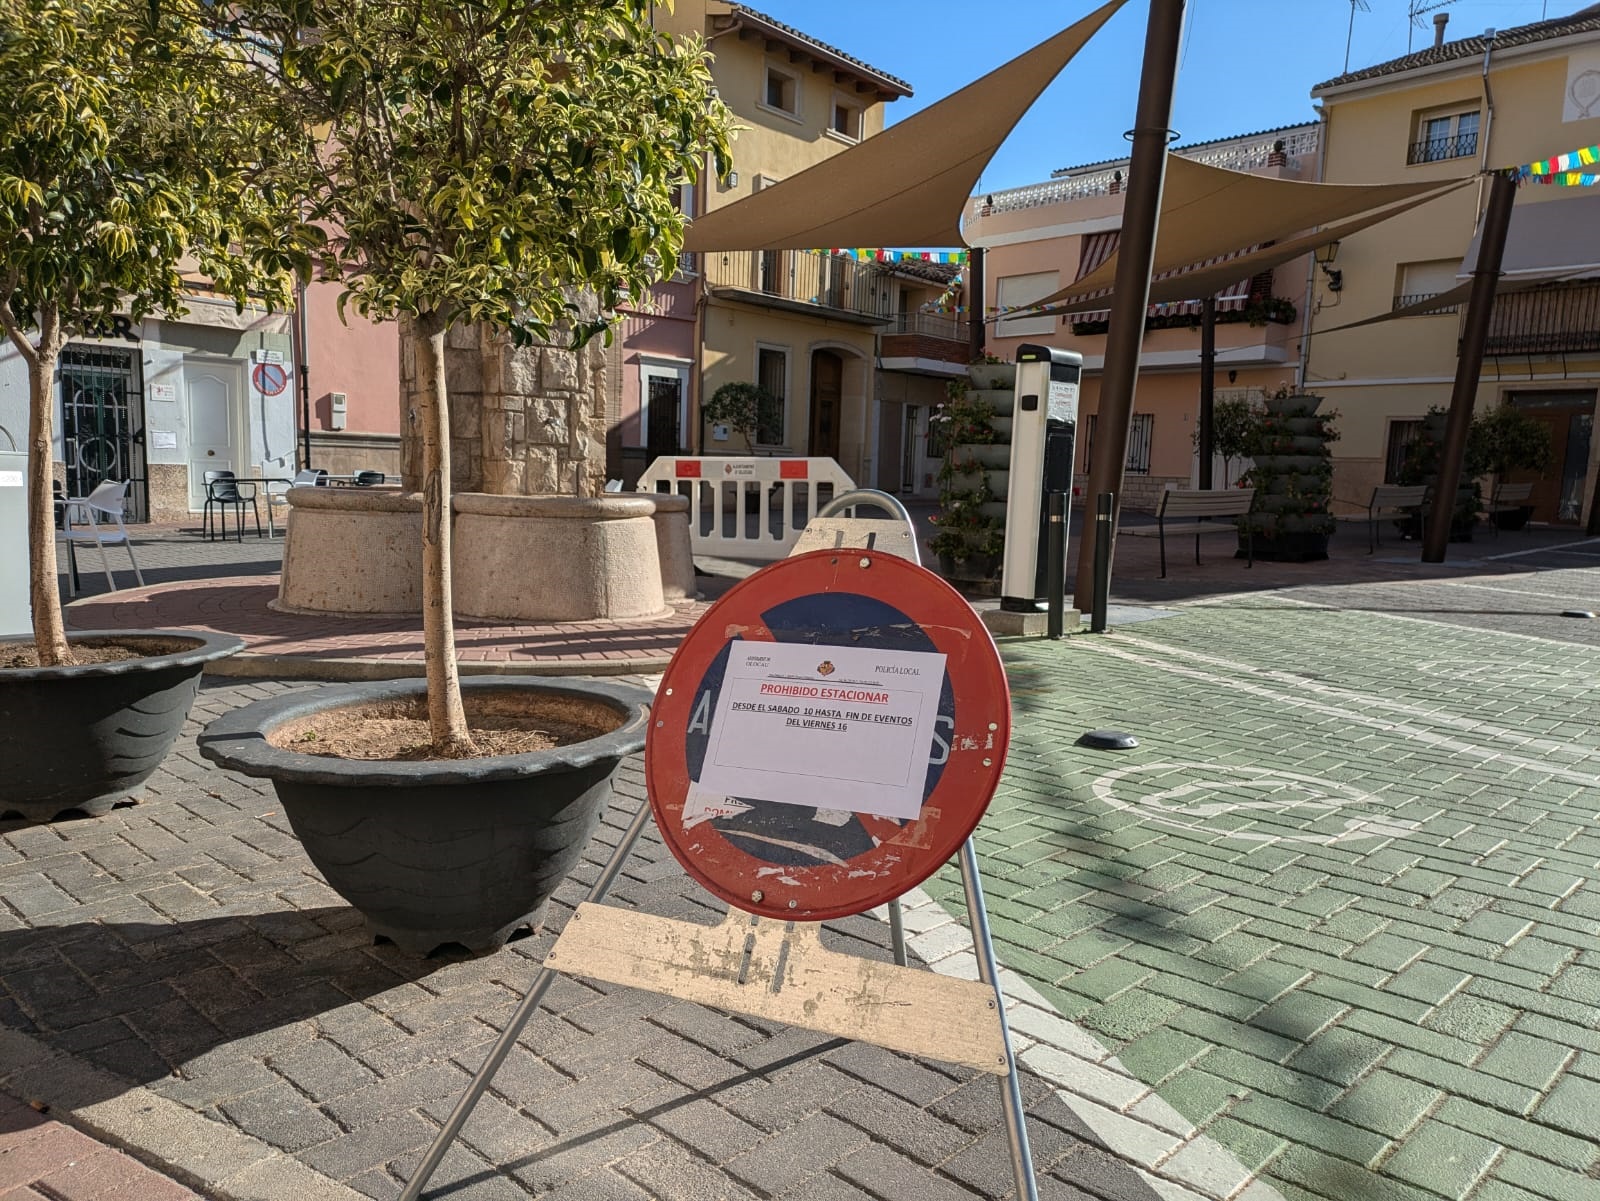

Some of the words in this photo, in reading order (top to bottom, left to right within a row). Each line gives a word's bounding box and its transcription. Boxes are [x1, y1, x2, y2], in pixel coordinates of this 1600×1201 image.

[874, 664, 899, 674] POLICÍA
[900, 666, 921, 676] LOCAL
[760, 683, 819, 697] PROHIBIDO
[821, 688, 889, 703] ESTACIONAR
[732, 702, 756, 711] DESDE
[757, 703, 766, 711] EL
[767, 704, 800, 714] SABADO
[803, 707, 814, 715] 10
[814, 708, 842, 718] HASTA
[845, 711, 859, 720] FIN
[861, 713, 873, 721] DE
[874, 714, 913, 725] EVENTOS
[786, 717, 801, 727] DEL
[802, 719, 836, 729] VIERNES
[837, 722, 848, 731] 16
